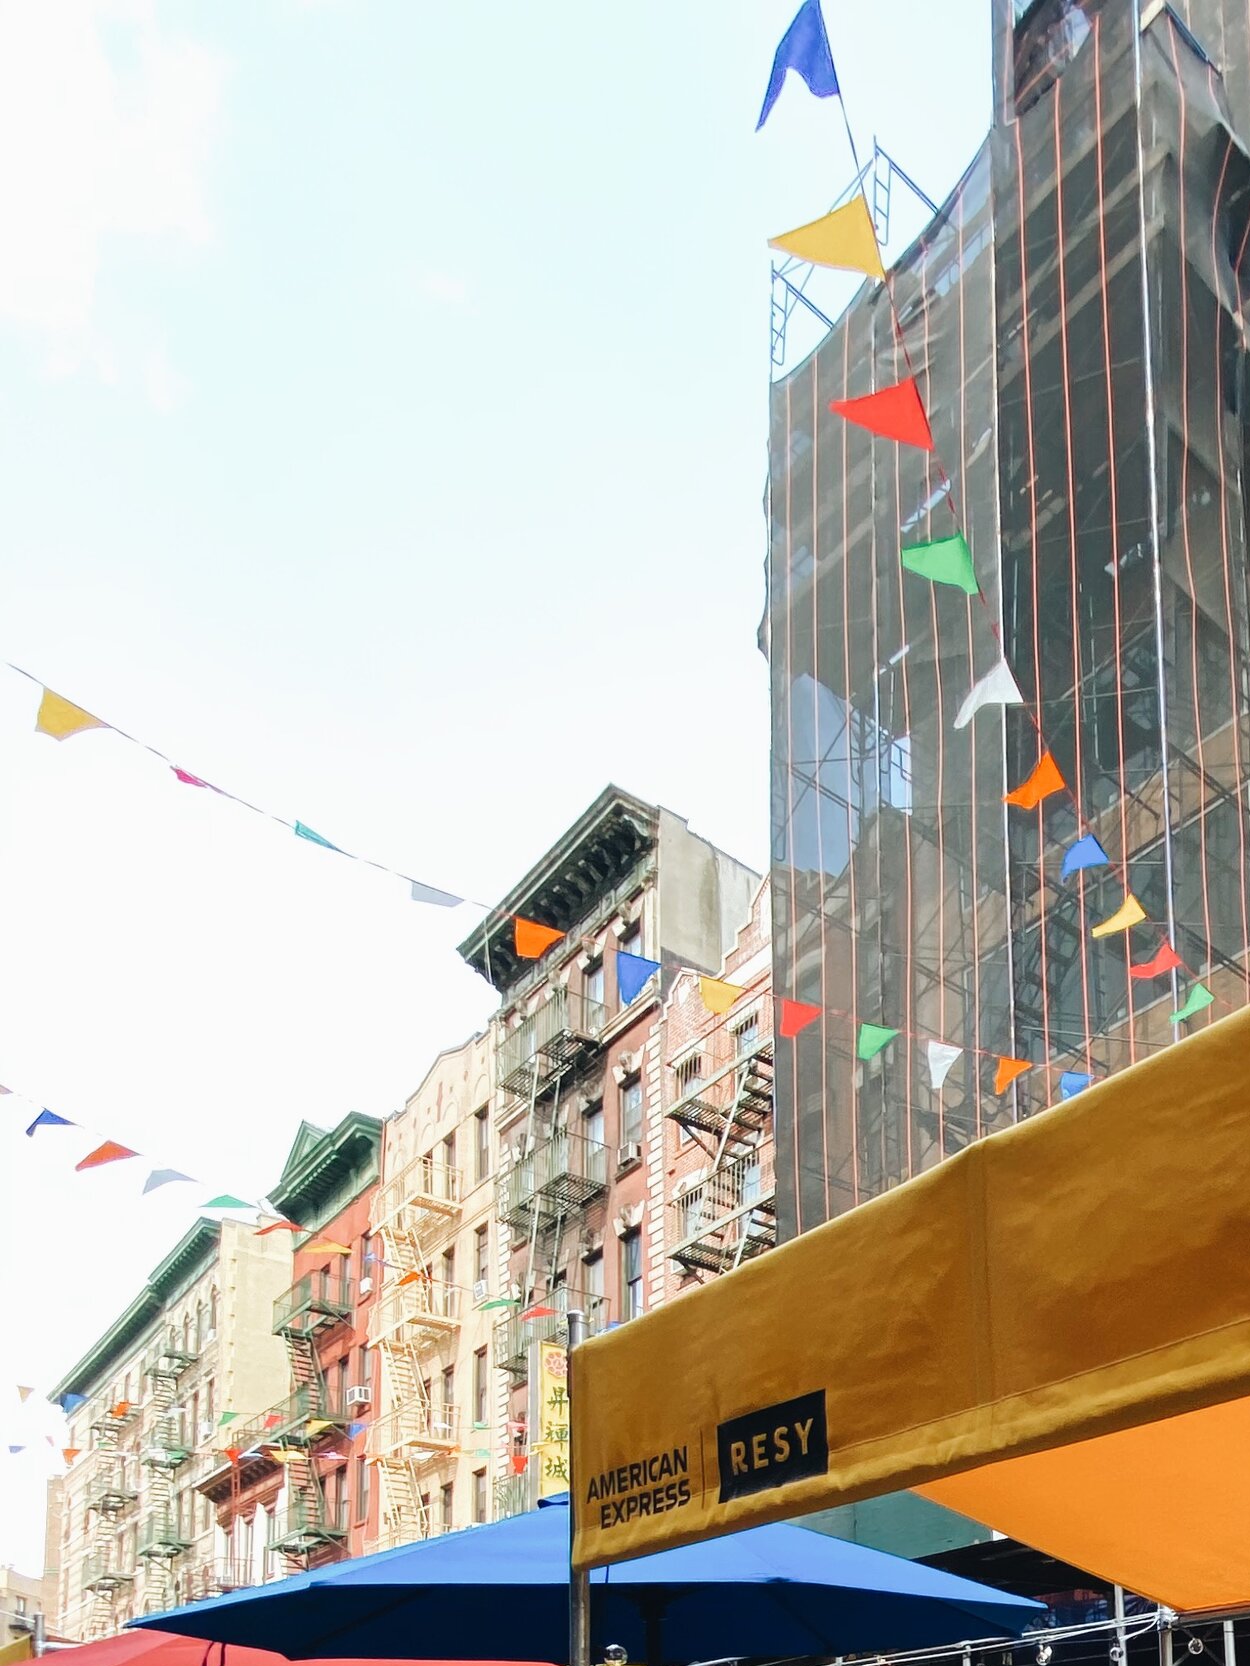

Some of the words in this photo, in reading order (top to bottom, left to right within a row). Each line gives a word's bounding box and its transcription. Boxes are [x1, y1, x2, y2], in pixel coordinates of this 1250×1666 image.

[586, 1446, 688, 1504] AMERICAN
[730, 1417, 815, 1477] RESY
[600, 1478, 691, 1530] EXPRESS
